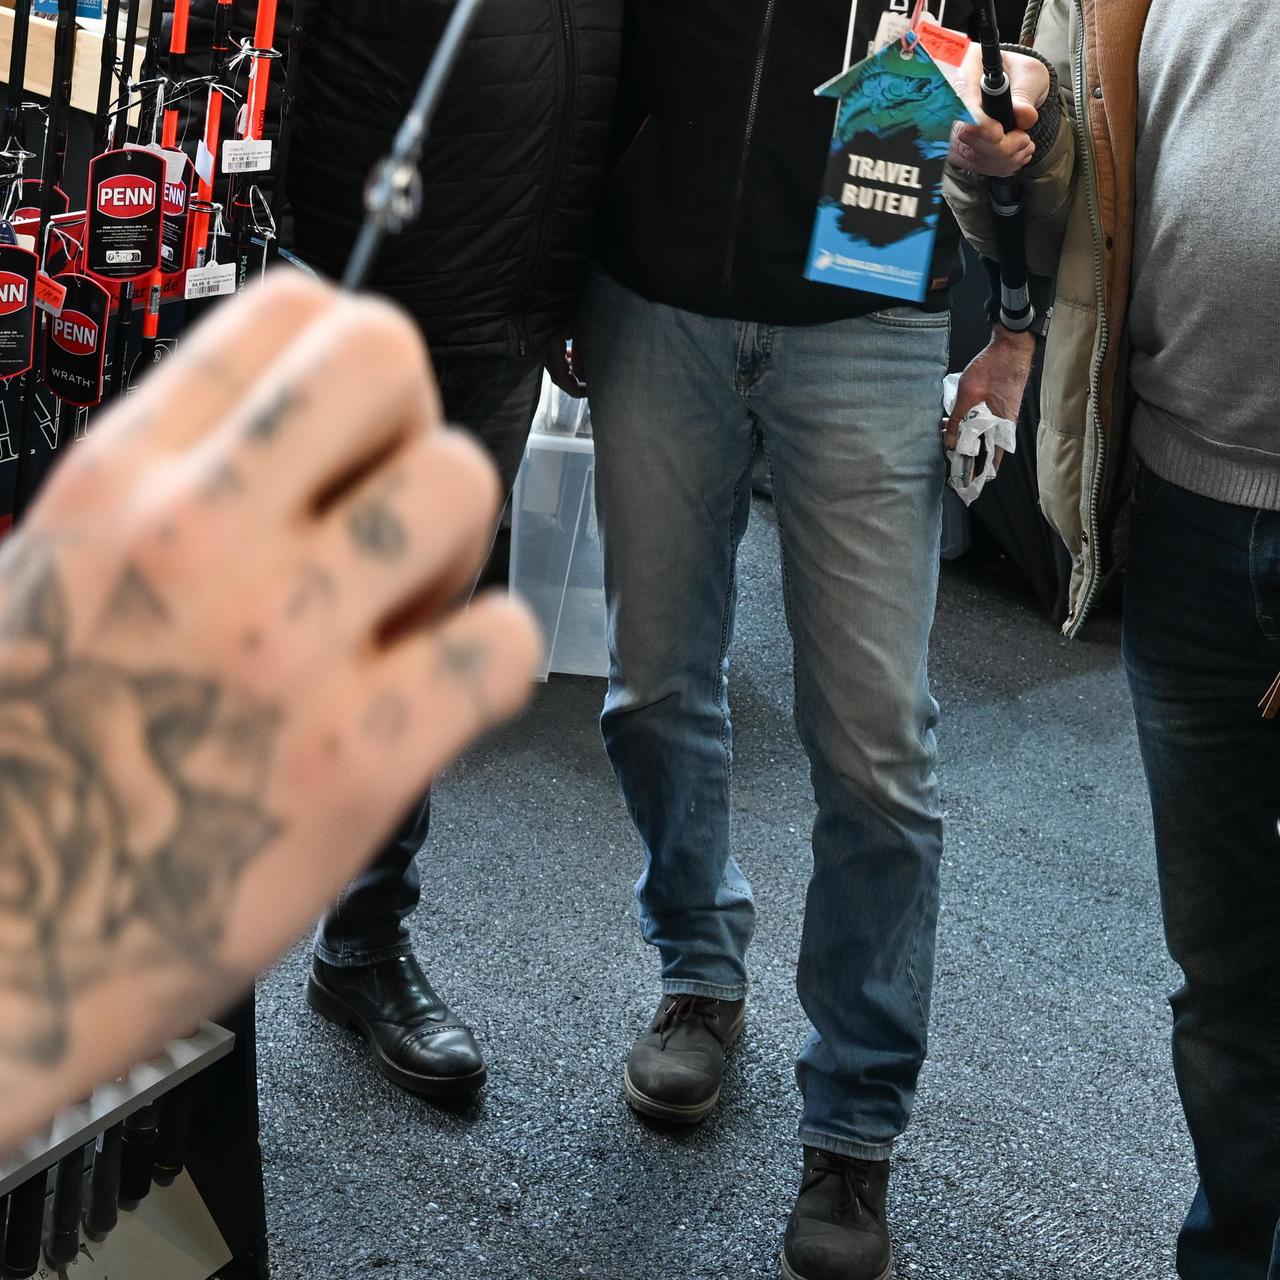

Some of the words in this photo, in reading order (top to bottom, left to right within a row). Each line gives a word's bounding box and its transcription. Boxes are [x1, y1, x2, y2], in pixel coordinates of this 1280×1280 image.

[847, 152, 923, 190] TRAVEL
[100, 187, 153, 207] PENN
[163, 182, 185, 208] ENN
[840, 181, 920, 219] RUTEN
[54, 318, 96, 347] PENN
